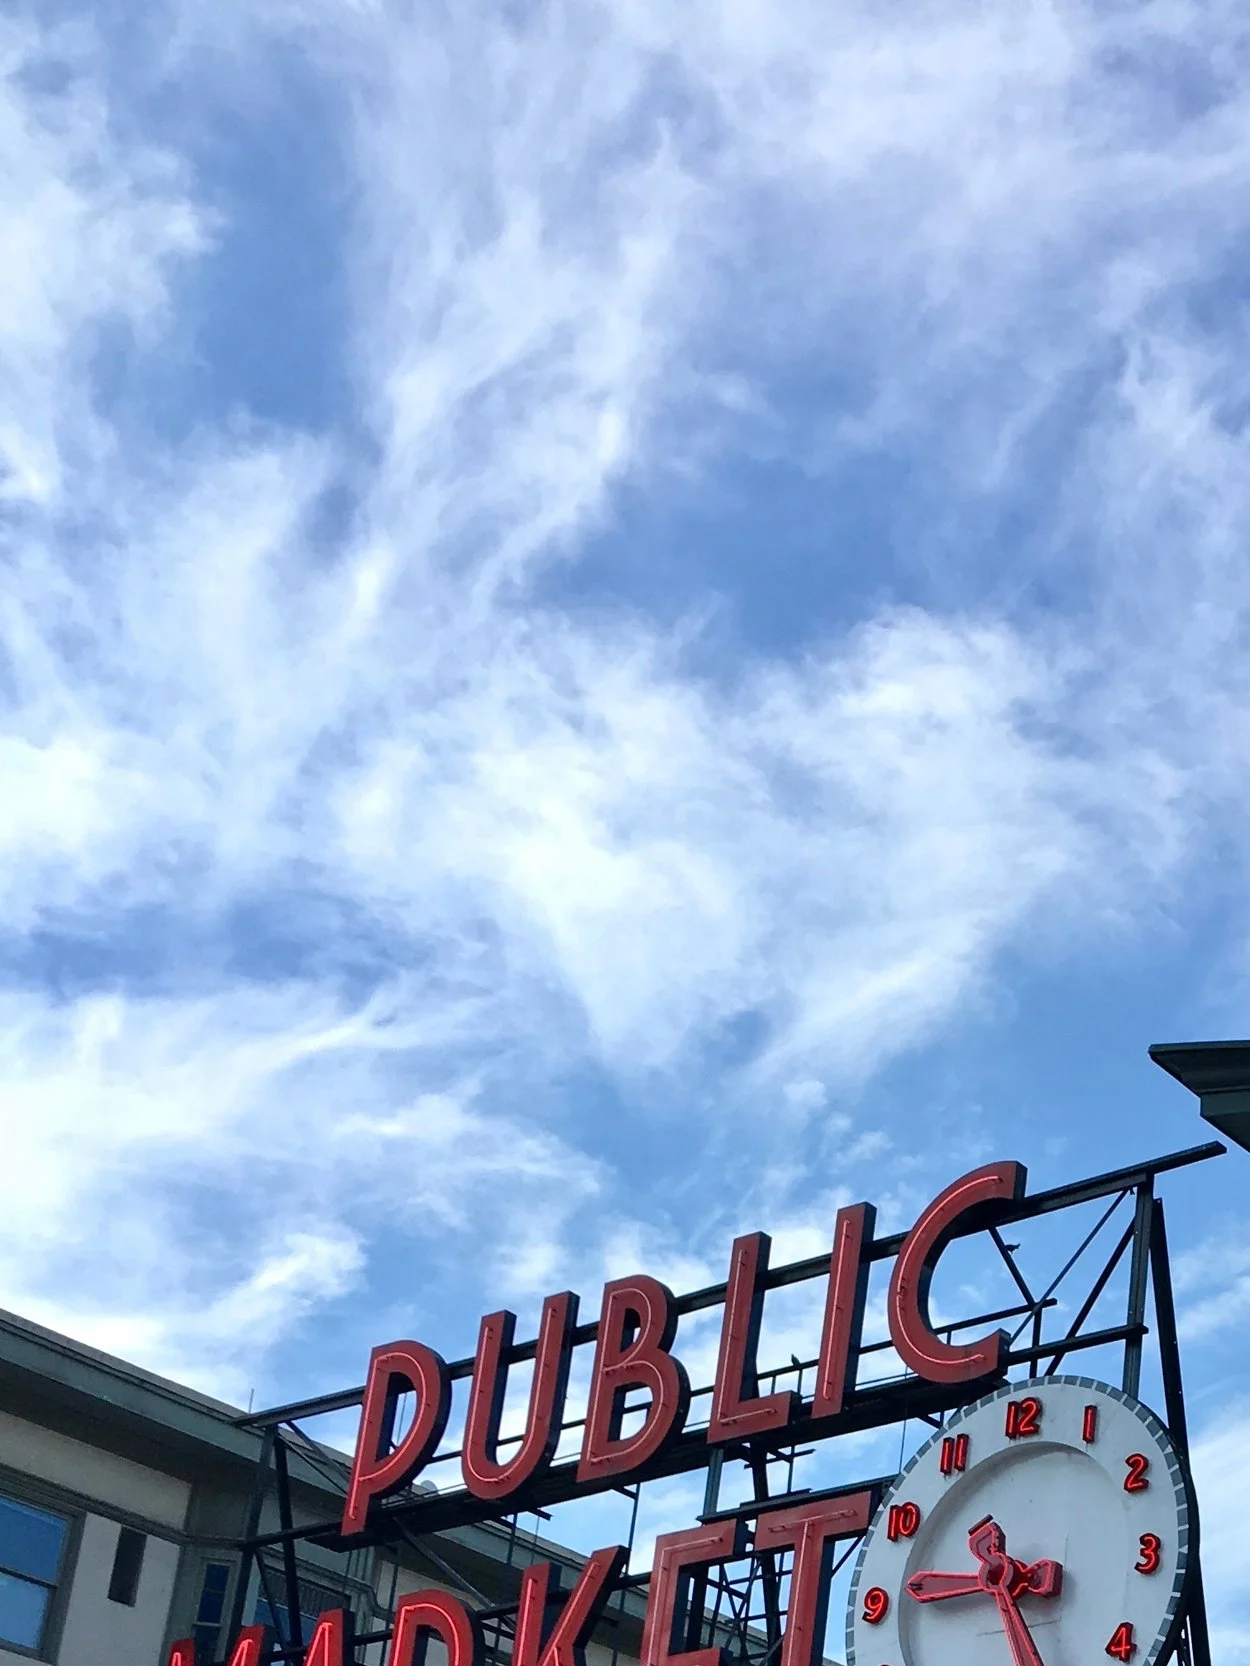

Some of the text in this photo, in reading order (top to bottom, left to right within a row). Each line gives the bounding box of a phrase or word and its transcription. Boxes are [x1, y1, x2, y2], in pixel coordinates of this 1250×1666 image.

[341, 1160, 1027, 1535] PUBLIC
[1005, 1396, 1043, 1439] 12
[1082, 1405, 1098, 1443] 1
[939, 1433, 969, 1475] 11
[1123, 1453, 1149, 1493] 2
[887, 1501, 920, 1542] 10
[1134, 1532, 1161, 1574] 3
[862, 1587, 889, 1624] 9
[1105, 1622, 1137, 1663] 4
